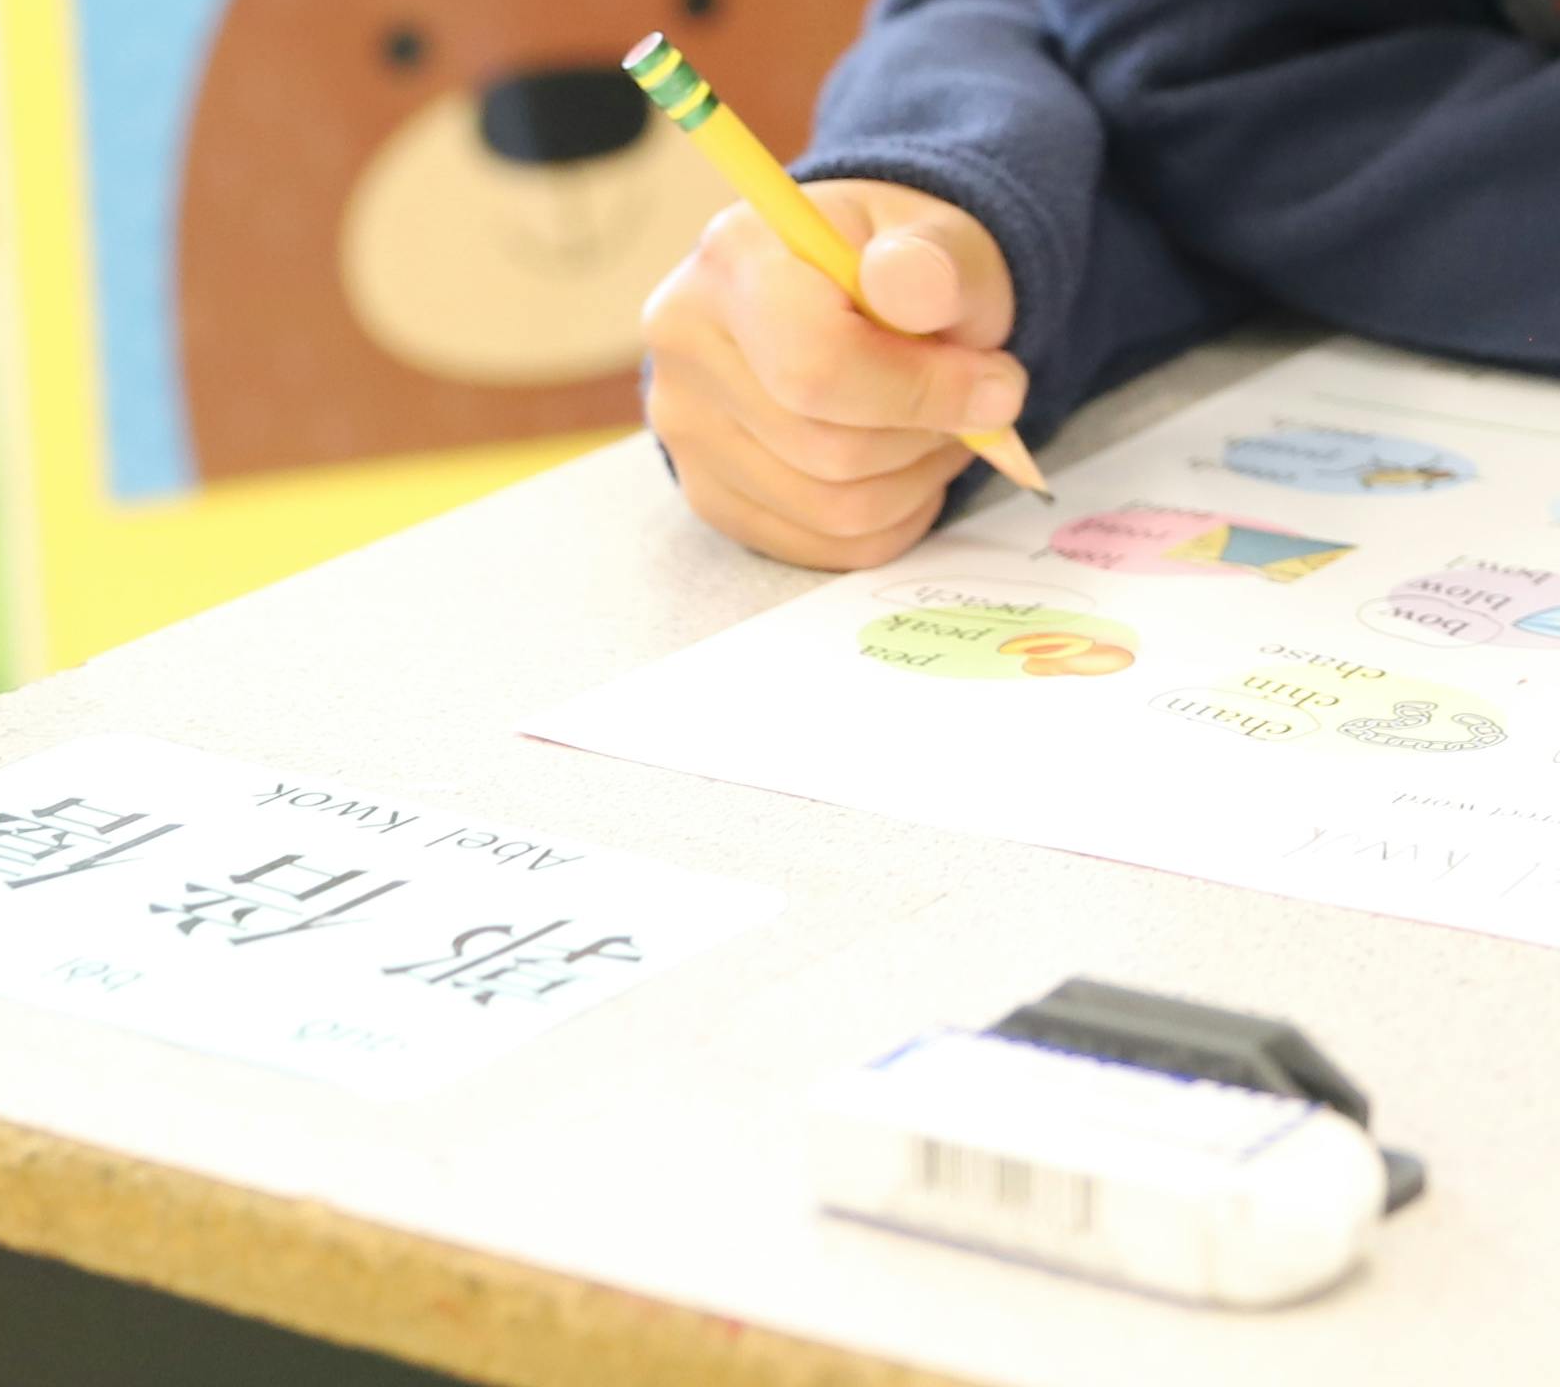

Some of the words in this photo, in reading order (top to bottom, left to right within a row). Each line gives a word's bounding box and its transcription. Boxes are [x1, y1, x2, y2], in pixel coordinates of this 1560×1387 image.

[912, 583, 1043, 616] peach
[1402, 577, 1513, 612] blow
[883, 612, 996, 641] peak
[1375, 605, 1469, 637] bow
[856, 643, 948, 667] pea
[1257, 642, 1387, 680] chase
[1241, 674, 1339, 708] chin
[1164, 696, 1292, 737] chain
[249, 780, 421, 835] Kwok
[423, 824, 587, 873] Abel
